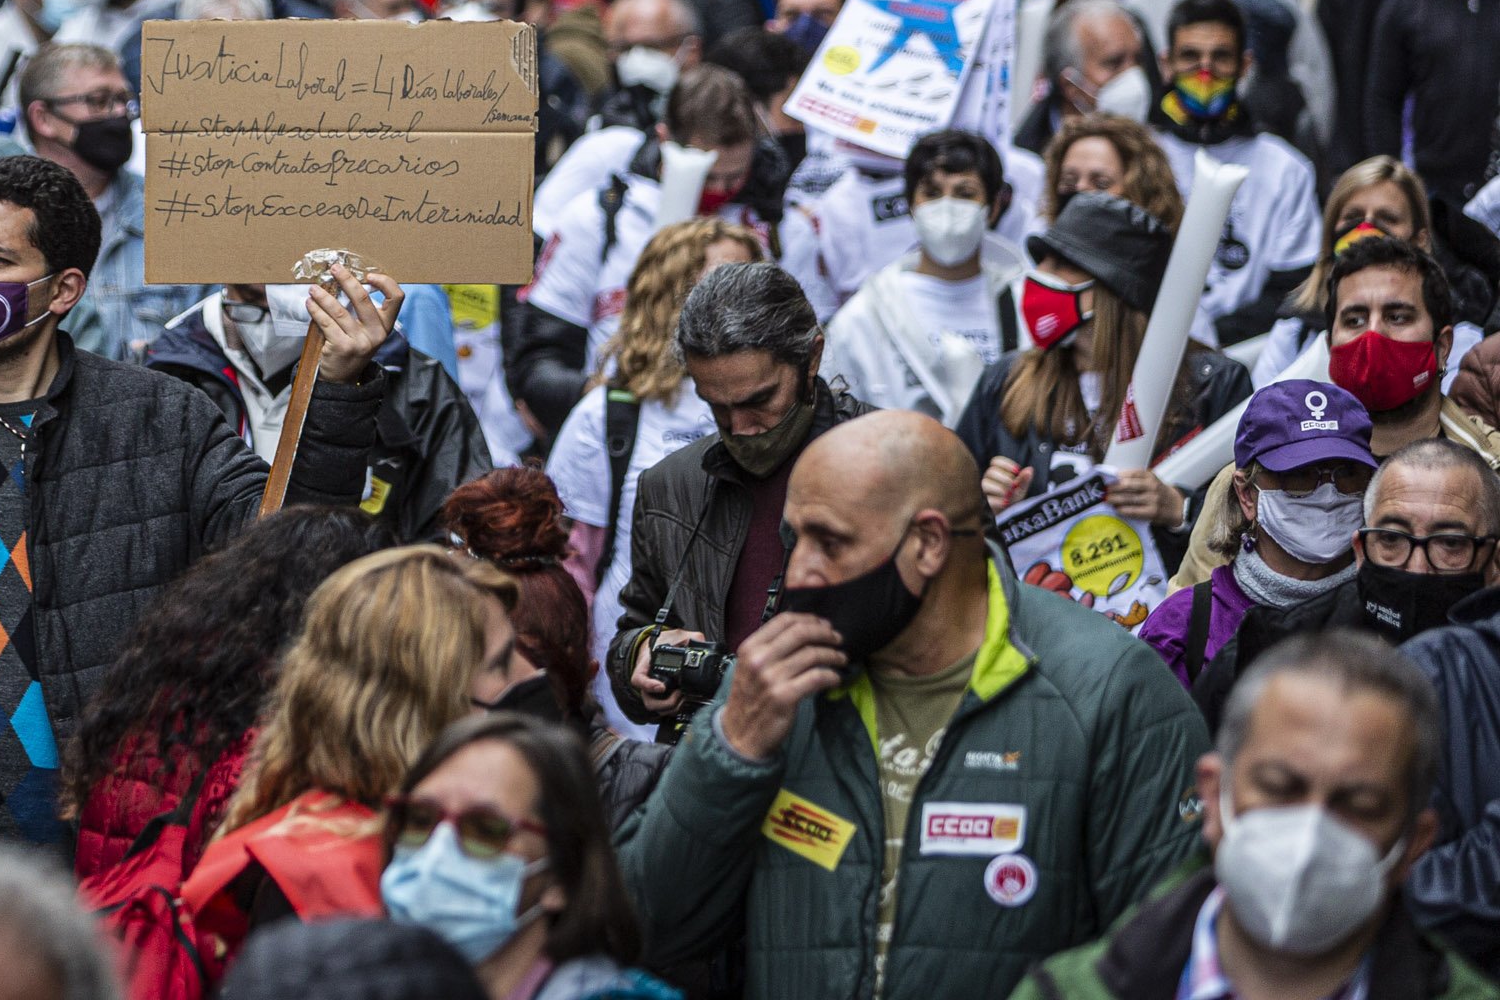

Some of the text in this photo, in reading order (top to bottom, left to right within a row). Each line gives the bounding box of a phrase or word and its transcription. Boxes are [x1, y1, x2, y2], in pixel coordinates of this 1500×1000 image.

[373, 54, 395, 111] 4
[1303, 421, 1327, 429] CCOO
[1069, 533, 1130, 568] 8.291
[930, 817, 990, 835] CCOO
